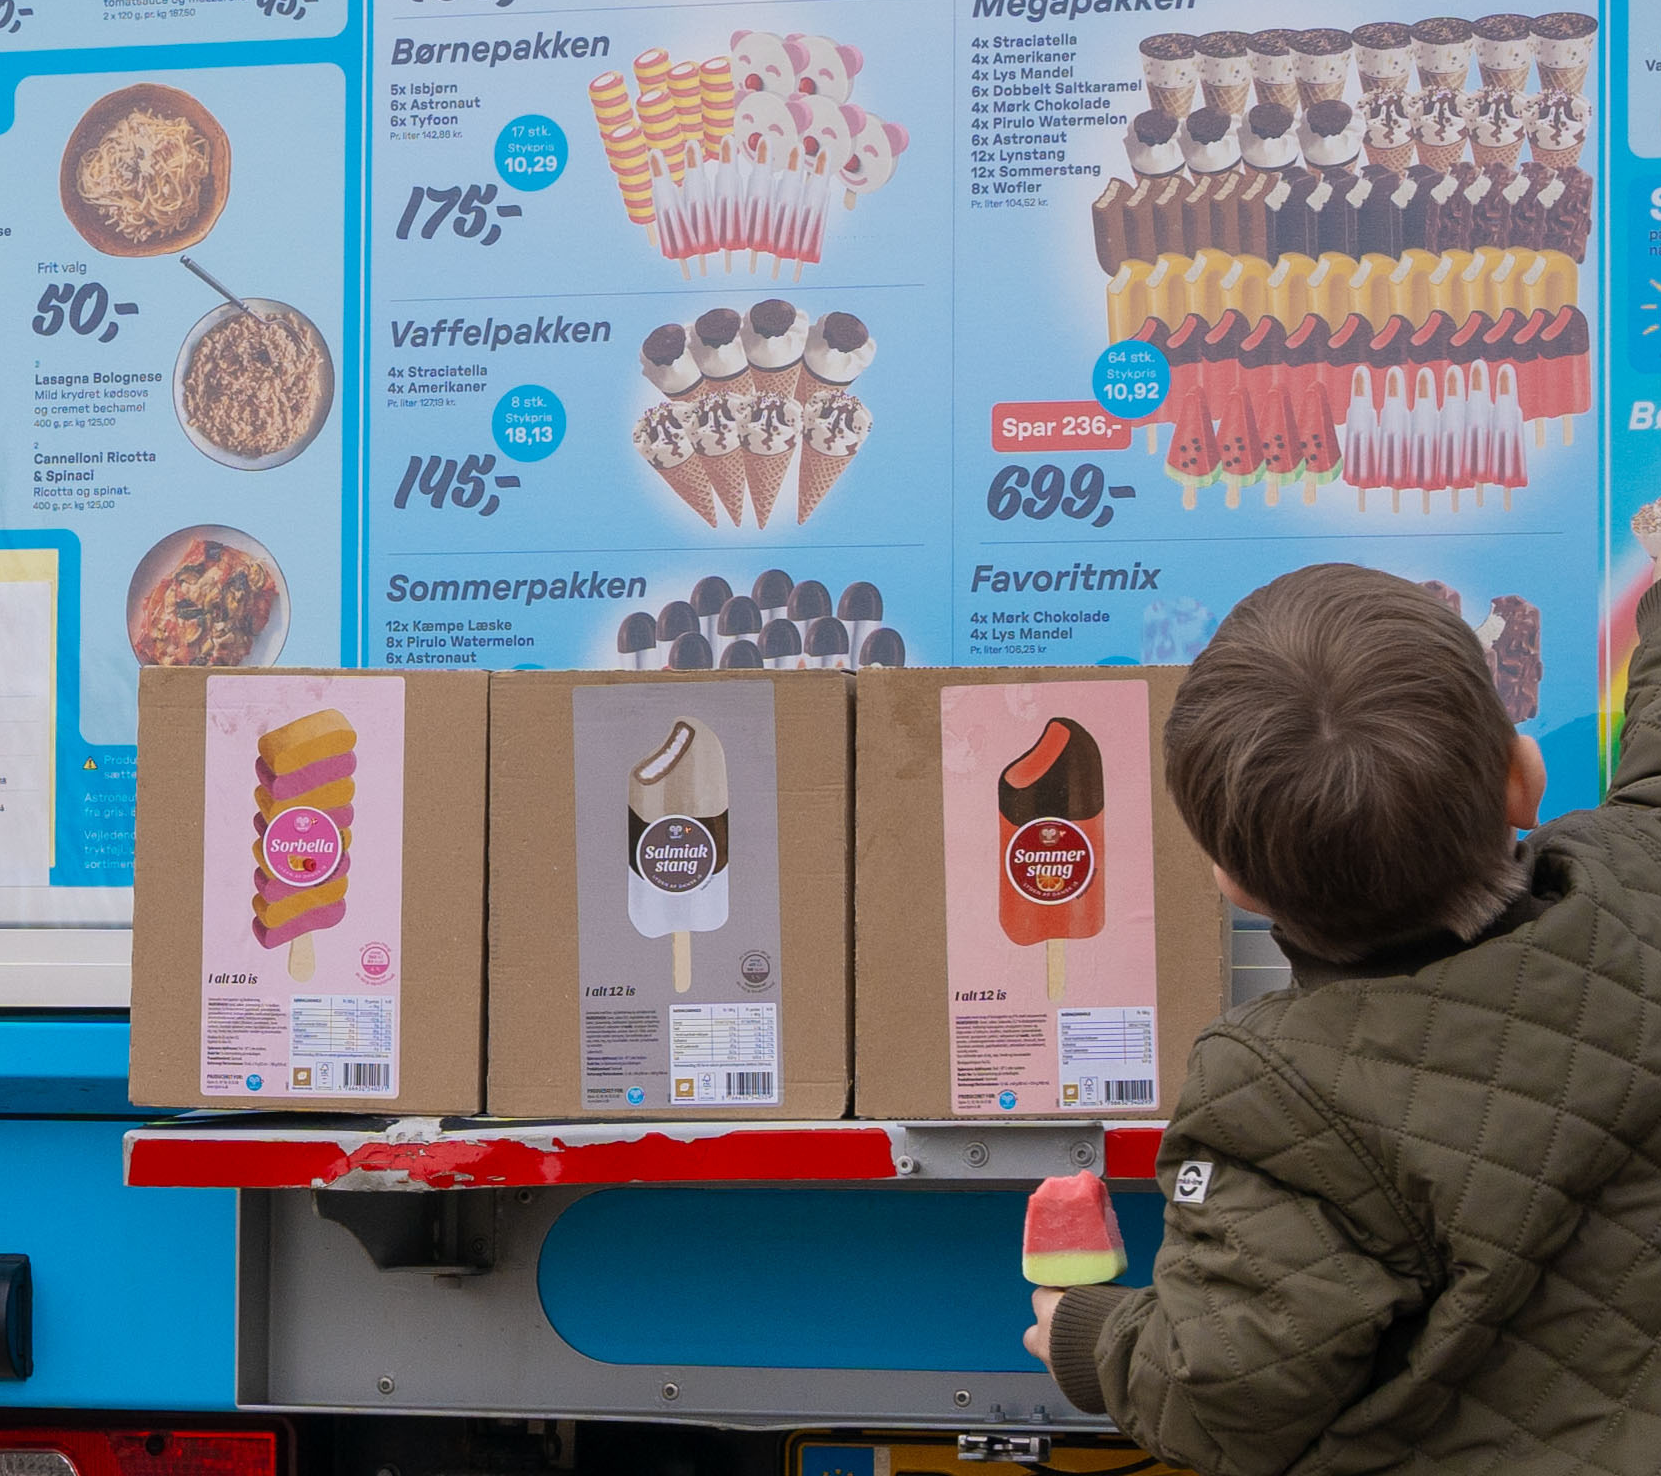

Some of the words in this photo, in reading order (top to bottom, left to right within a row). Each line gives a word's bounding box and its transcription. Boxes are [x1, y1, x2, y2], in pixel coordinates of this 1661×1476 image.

[391, 31, 609, 67] Børnepakken
[395, 183, 523, 247] 175,-
[32, 282, 139, 343] 50,-
[392, 316, 611, 351] Vaffelpakken
[1003, 418, 1056, 440] Spar
[1063, 415, 1122, 439] 236,-
[394, 453, 521, 516] 145,-
[987, 464, 1136, 527] 699,-
[387, 571, 646, 606] Sommerpakken
[971, 562, 1161, 592] Favoritmix
[271, 839, 333, 852] Sorbella
[645, 844, 707, 859] Salmiak
[1015, 849, 1085, 863] Sommer
[655, 860, 697, 874] stang
[1026, 864, 1074, 879] stang
[215, 973, 230, 983] alt
[232, 974, 246, 983] 10
[248, 974, 257, 984] is
